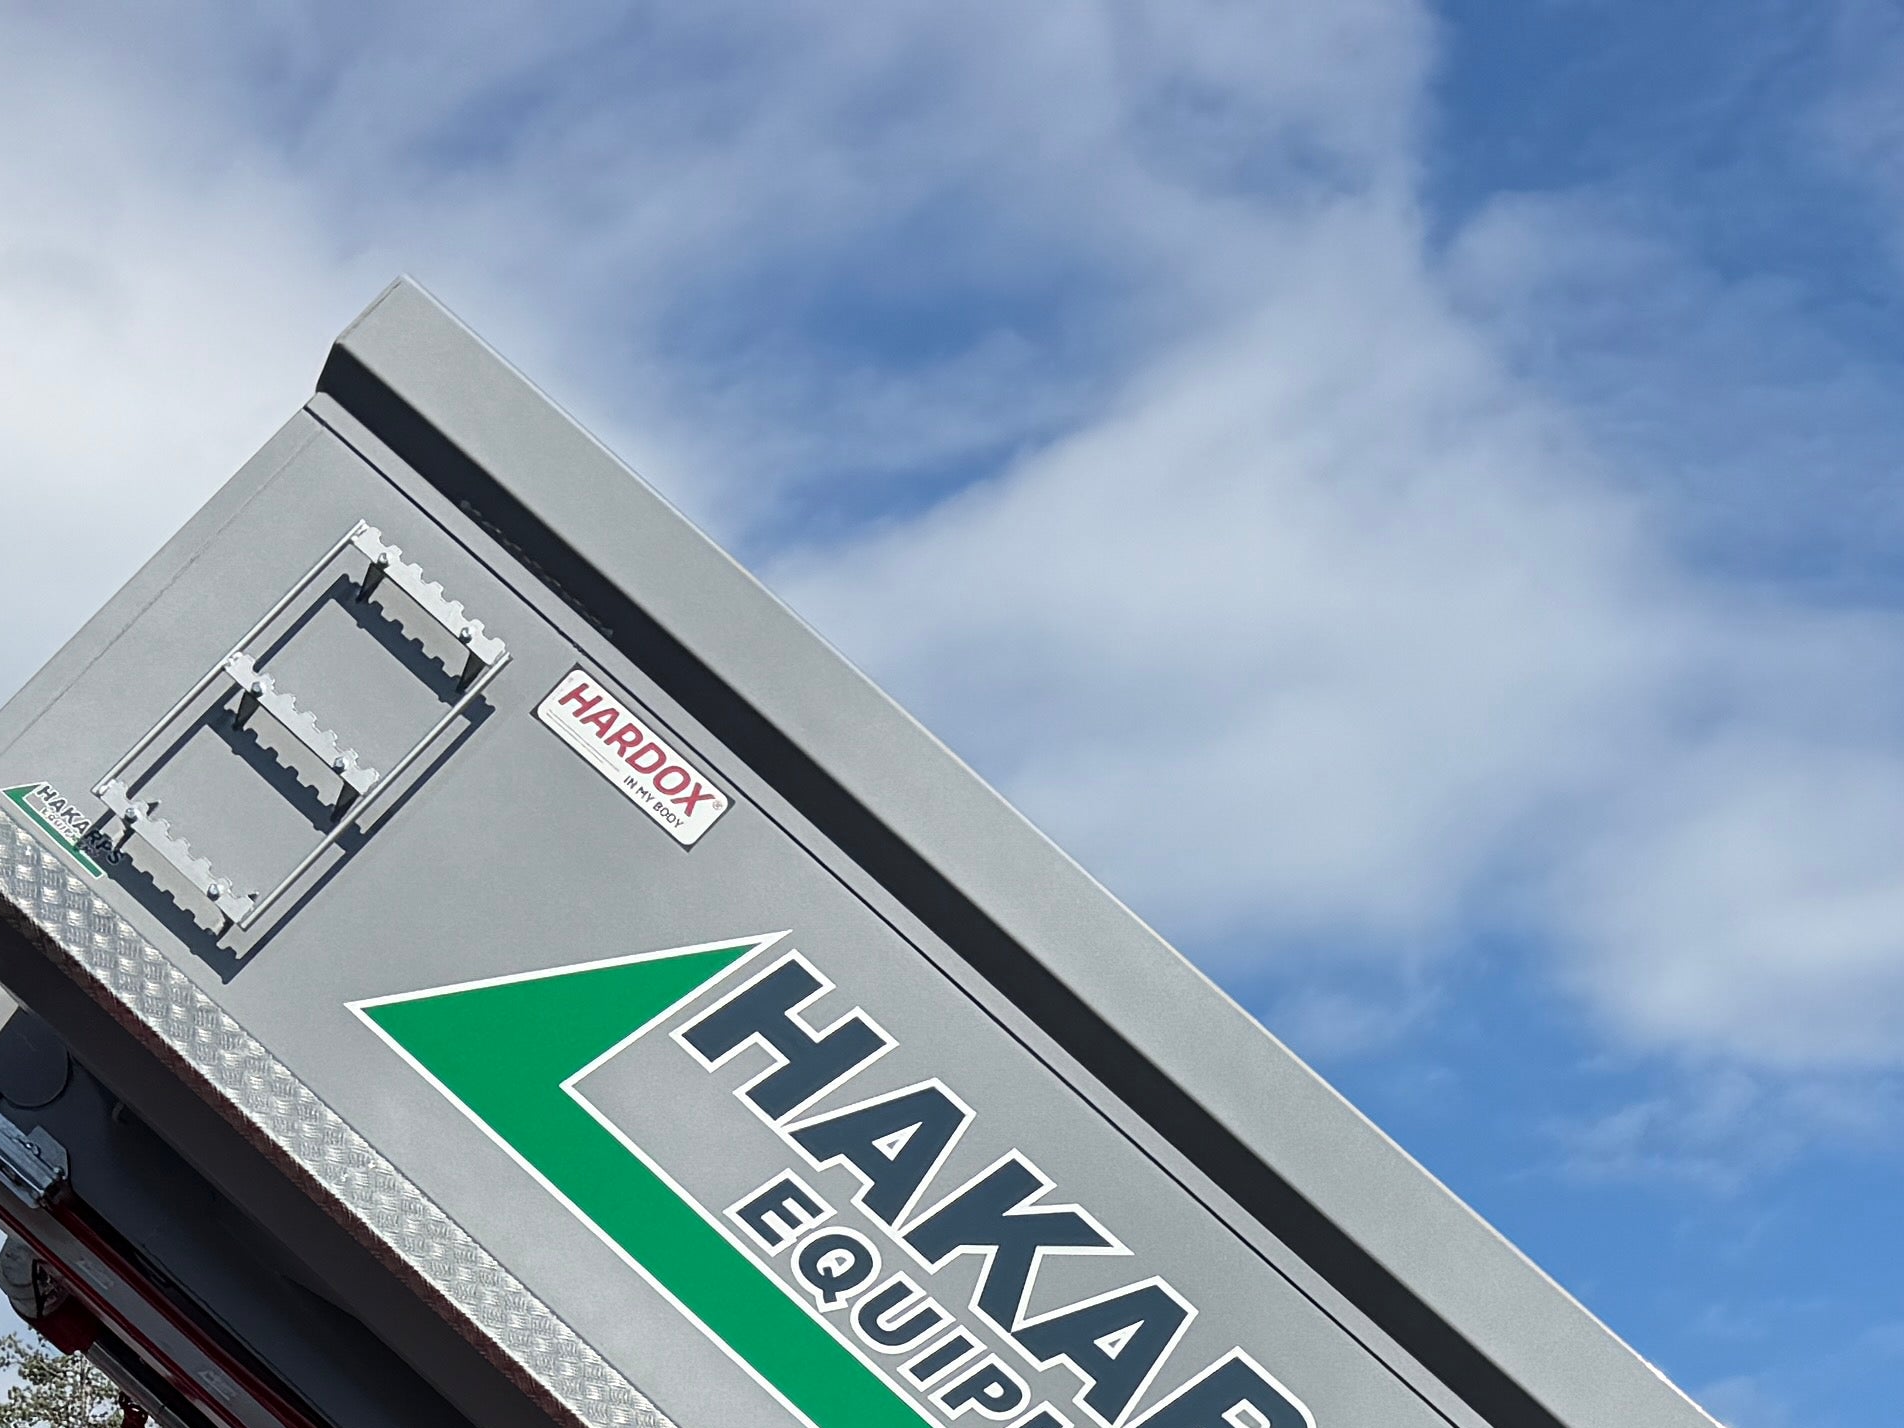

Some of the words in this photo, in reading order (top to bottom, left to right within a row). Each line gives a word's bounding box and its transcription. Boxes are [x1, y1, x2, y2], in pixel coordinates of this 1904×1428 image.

[558, 682, 716, 817] HARDOX
[34, 783, 124, 864] HAKARPS
[623, 775, 638, 790] IN
[635, 786, 655, 803] MY
[653, 801, 684, 829] BODY
